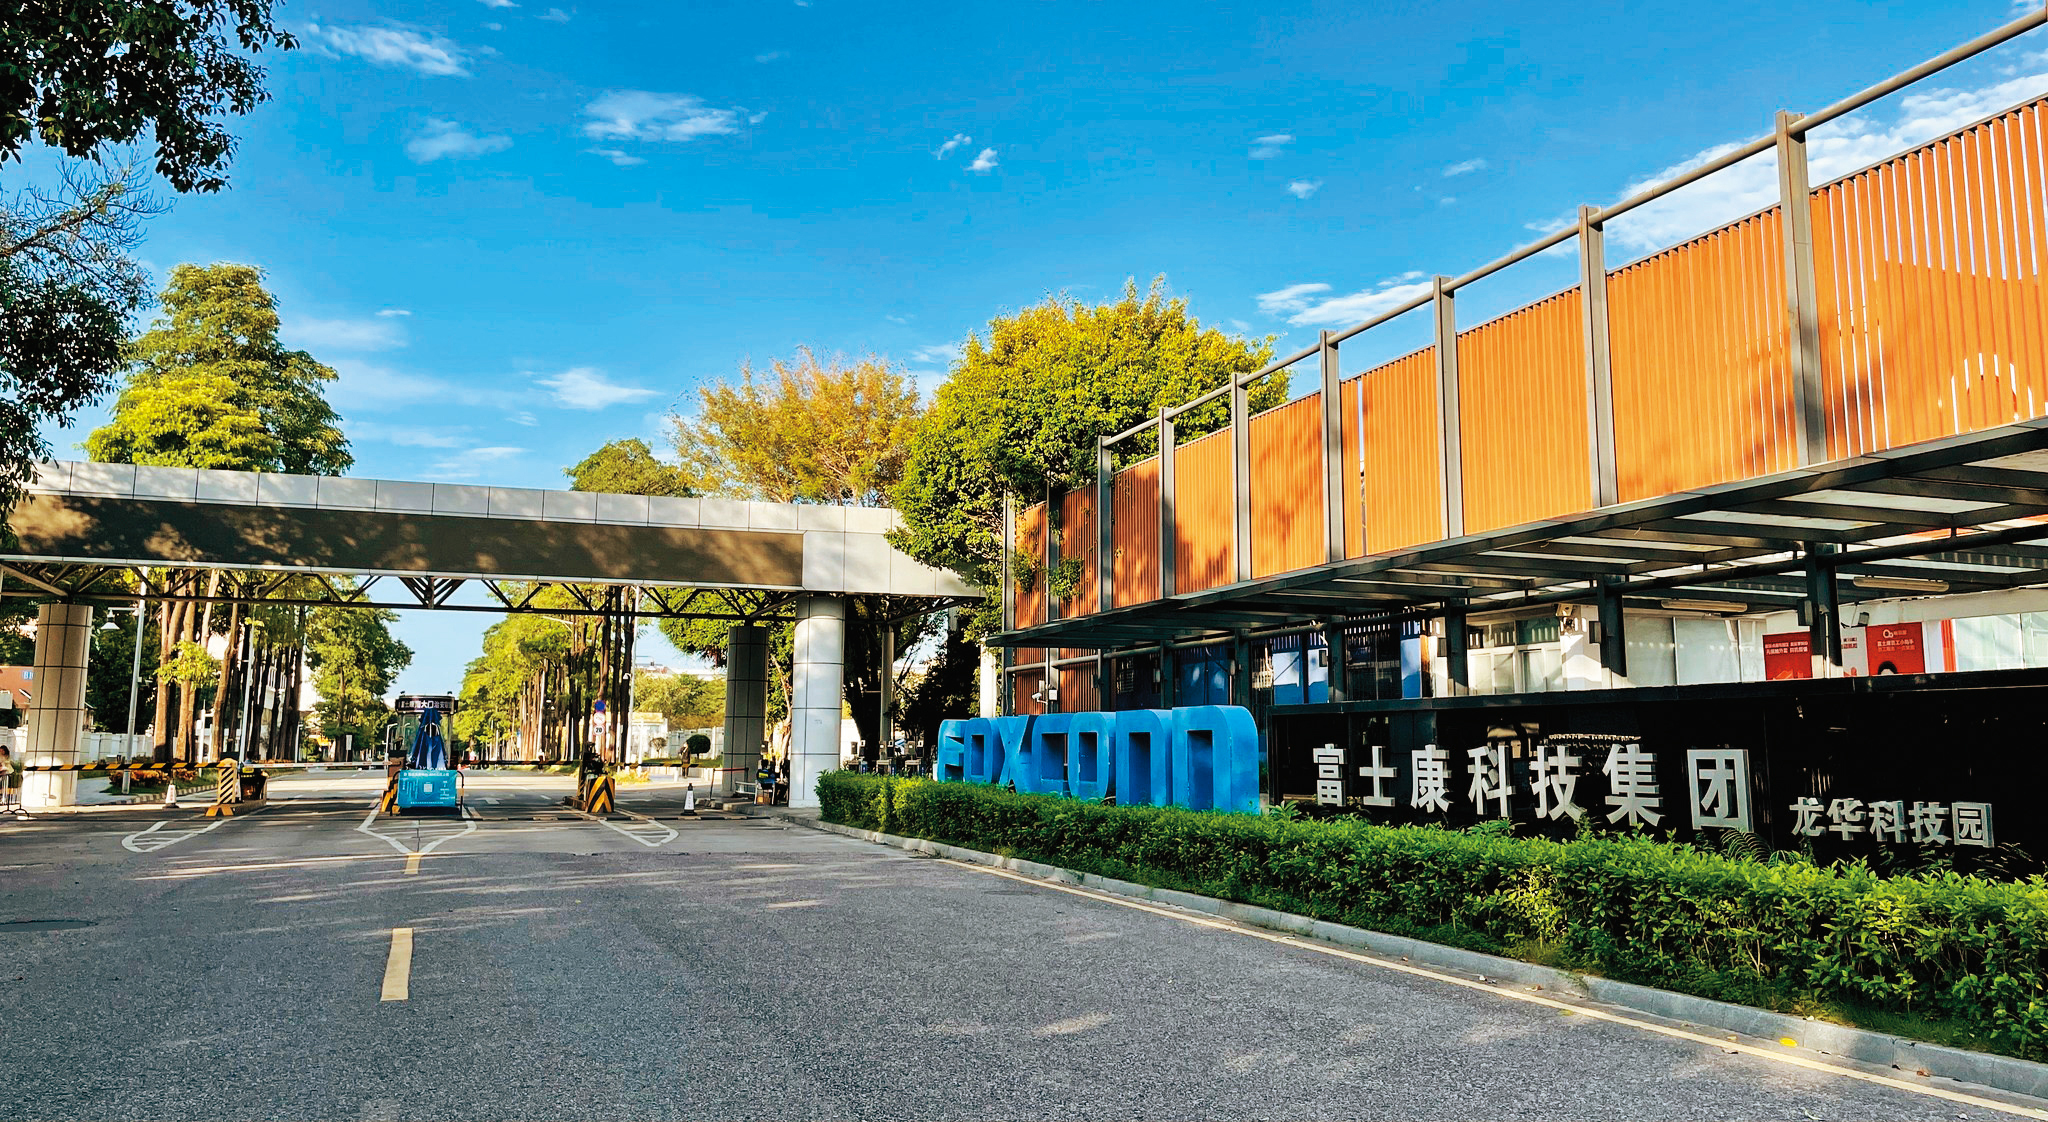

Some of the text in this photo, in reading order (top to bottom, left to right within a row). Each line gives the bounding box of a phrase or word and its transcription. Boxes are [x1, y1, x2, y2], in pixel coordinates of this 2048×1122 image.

[937, 705, 1260, 815] FOXCONN
[1312, 743, 1752, 832] 富士康科技集团
[1789, 796, 1994, 849] 龙华科技园
